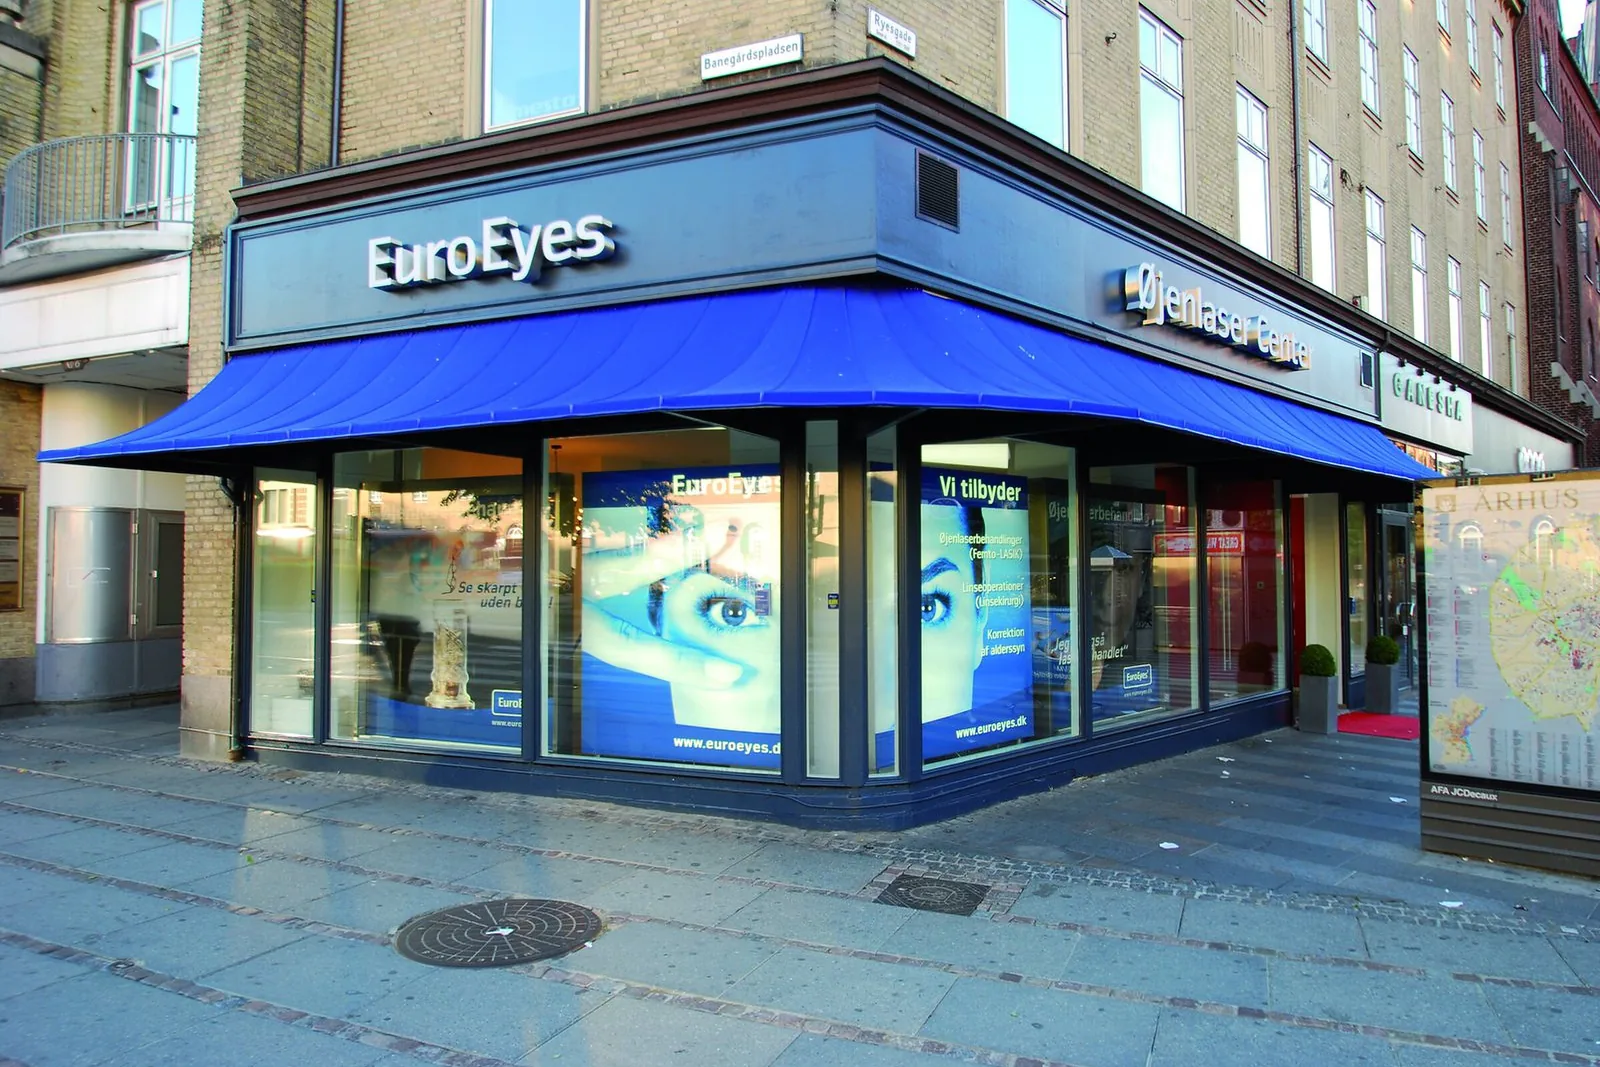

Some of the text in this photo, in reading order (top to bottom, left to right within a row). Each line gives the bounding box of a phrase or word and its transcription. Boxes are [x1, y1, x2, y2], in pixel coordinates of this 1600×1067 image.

[874, 13, 912, 44] Ryesgade
[703, 42, 799, 70] Banegårdspladsen
[368, 214, 614, 290] EuroEyes
[1126, 262, 1249, 347] Øjenlaser
[1392, 372, 1463, 421] GANESHA
[939, 475, 1022, 505] Vi tilbyder
[1474, 487, 1580, 512] ÅRHUS
[938, 532, 1023, 547] Øjenlaserbehandlinger
[458, 581, 518, 596] Se skarpt
[962, 581, 1025, 594] Linseoperationer
[480, 596, 511, 608] uden
[987, 627, 1025, 640] Korrektion
[980, 643, 1026, 657] af alderssyn
[955, 715, 1028, 739] www.euroeyes.dk
[673, 737, 781, 755] www.euroeyes.d
[1430, 784, 1498, 801] AFA JCDecaux
